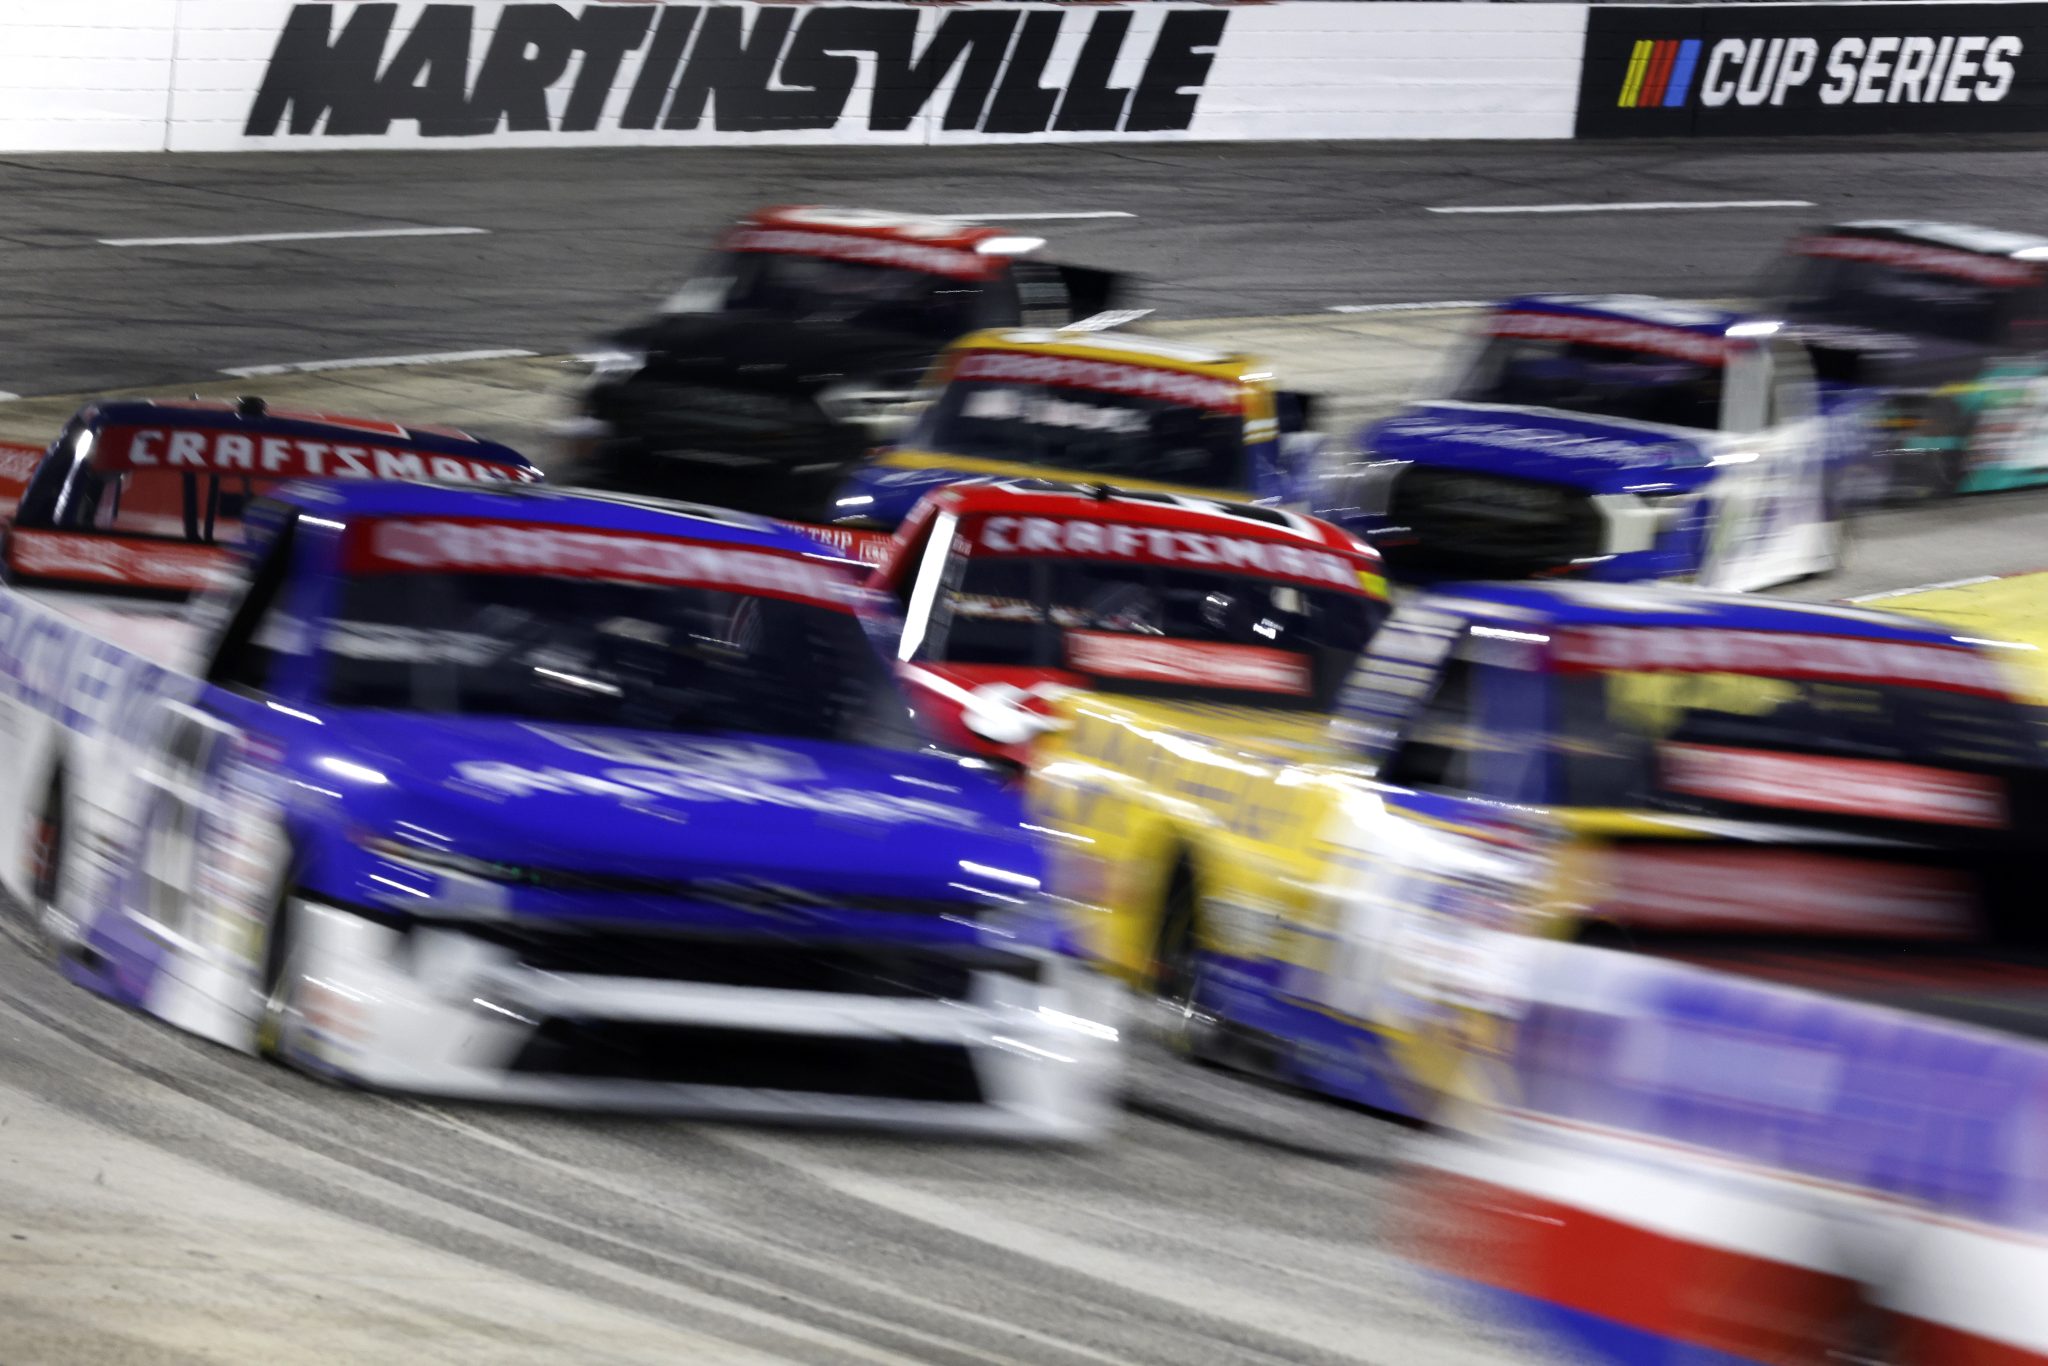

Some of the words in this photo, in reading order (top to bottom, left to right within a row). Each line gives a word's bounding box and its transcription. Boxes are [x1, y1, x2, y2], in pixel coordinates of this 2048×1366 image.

[243, 3, 1229, 136] MARTINSVILLE
[1700, 37, 1819, 106] CUP
[1819, 36, 2024, 104] SERIES
